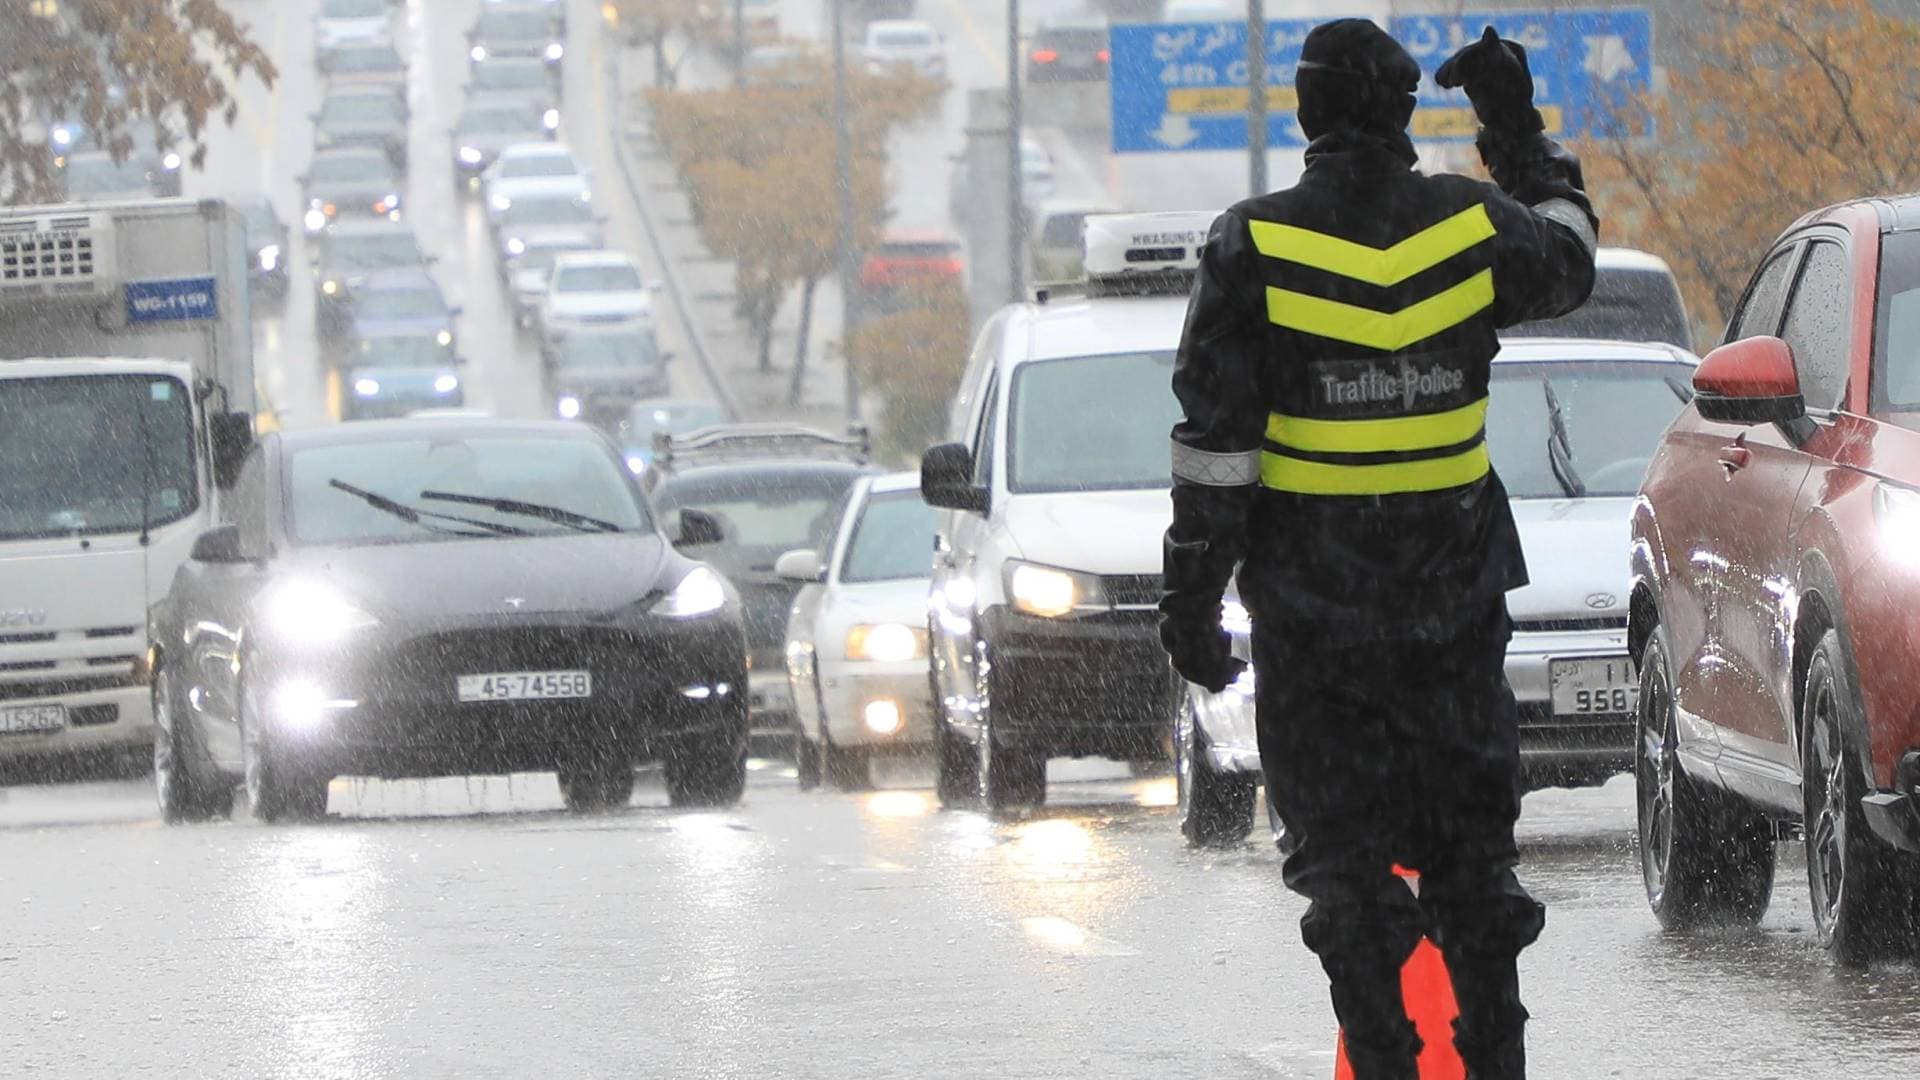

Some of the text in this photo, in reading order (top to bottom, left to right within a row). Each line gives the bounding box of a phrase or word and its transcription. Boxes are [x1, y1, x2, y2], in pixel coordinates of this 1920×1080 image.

[1320, 363, 1465, 404] Traffic Police
[482, 675, 586, 697] 45-74558
